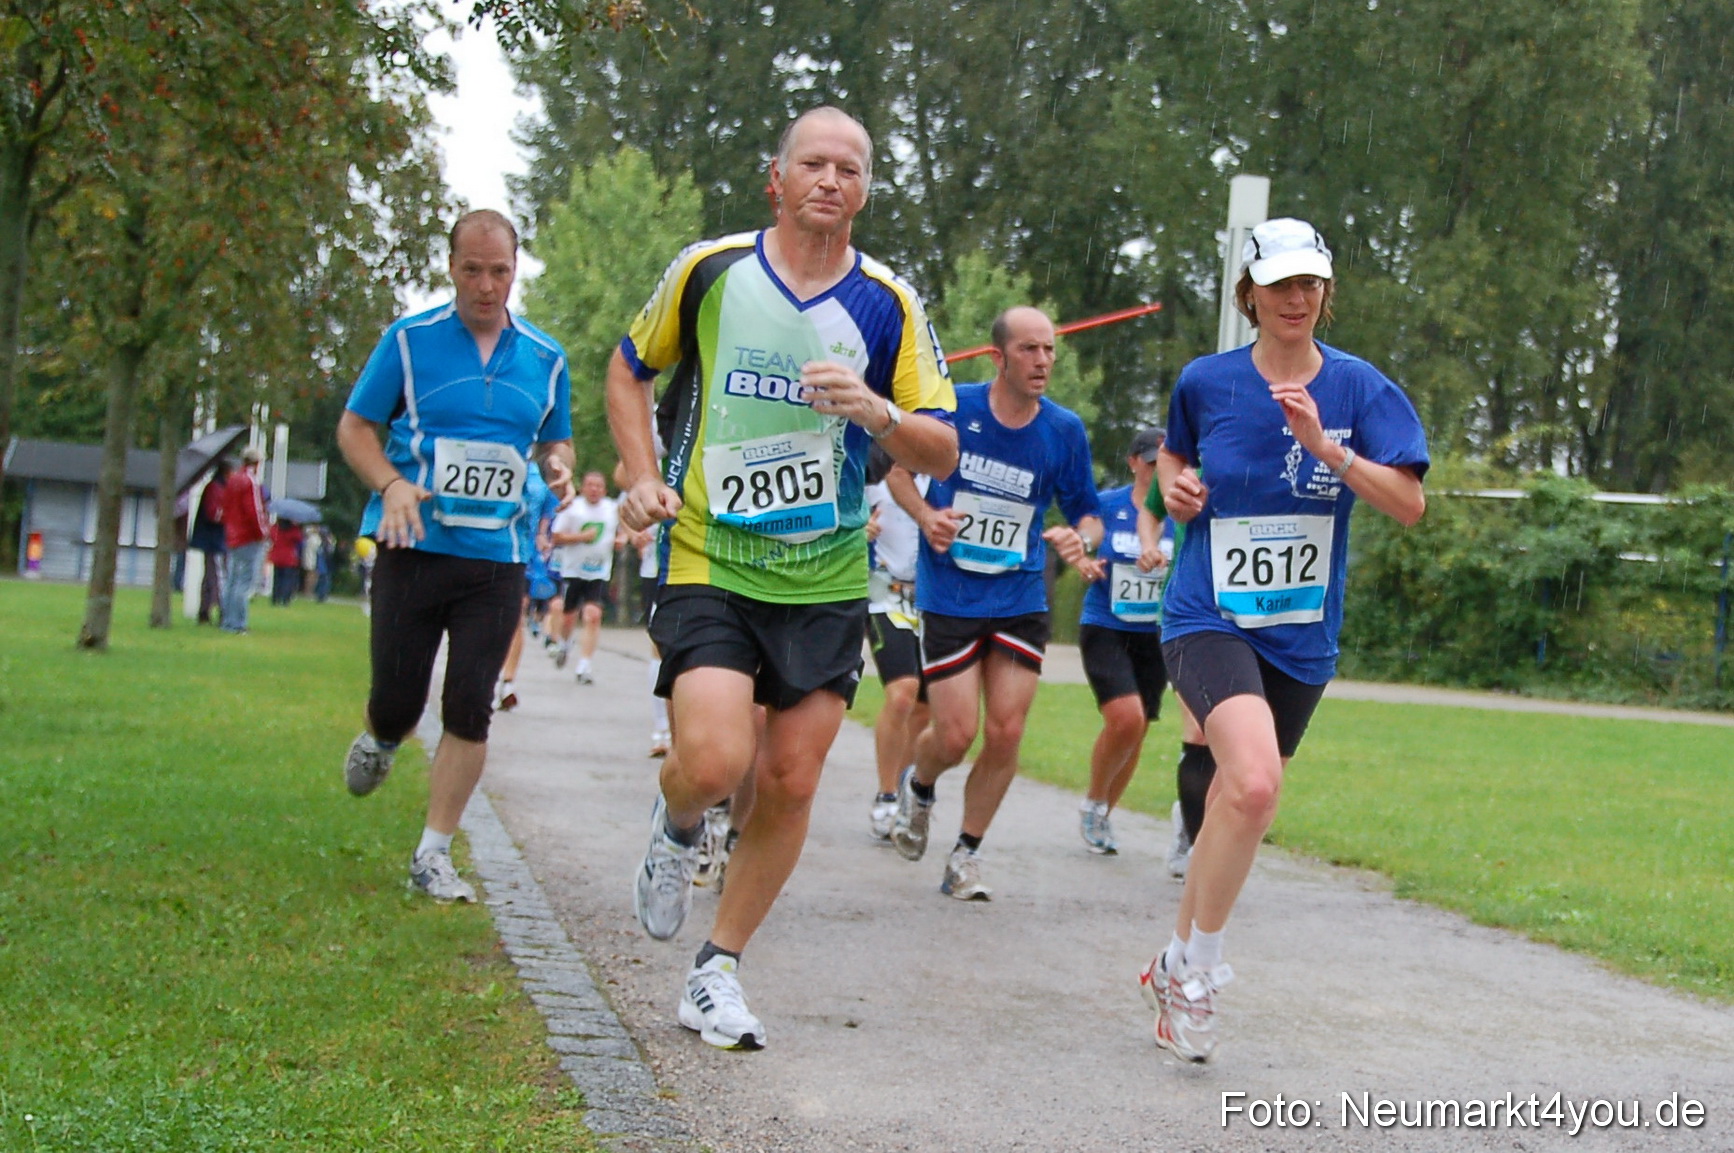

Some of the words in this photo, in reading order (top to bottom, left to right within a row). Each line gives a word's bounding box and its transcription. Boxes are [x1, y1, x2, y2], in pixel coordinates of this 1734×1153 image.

[443, 464, 515, 497] 2673
[722, 459, 824, 514] 2805
[960, 452, 1034, 490] HUBER
[957, 514, 1021, 548] 2167
[1226, 544, 1319, 586] 2612
[1256, 594, 1292, 611] Karin
